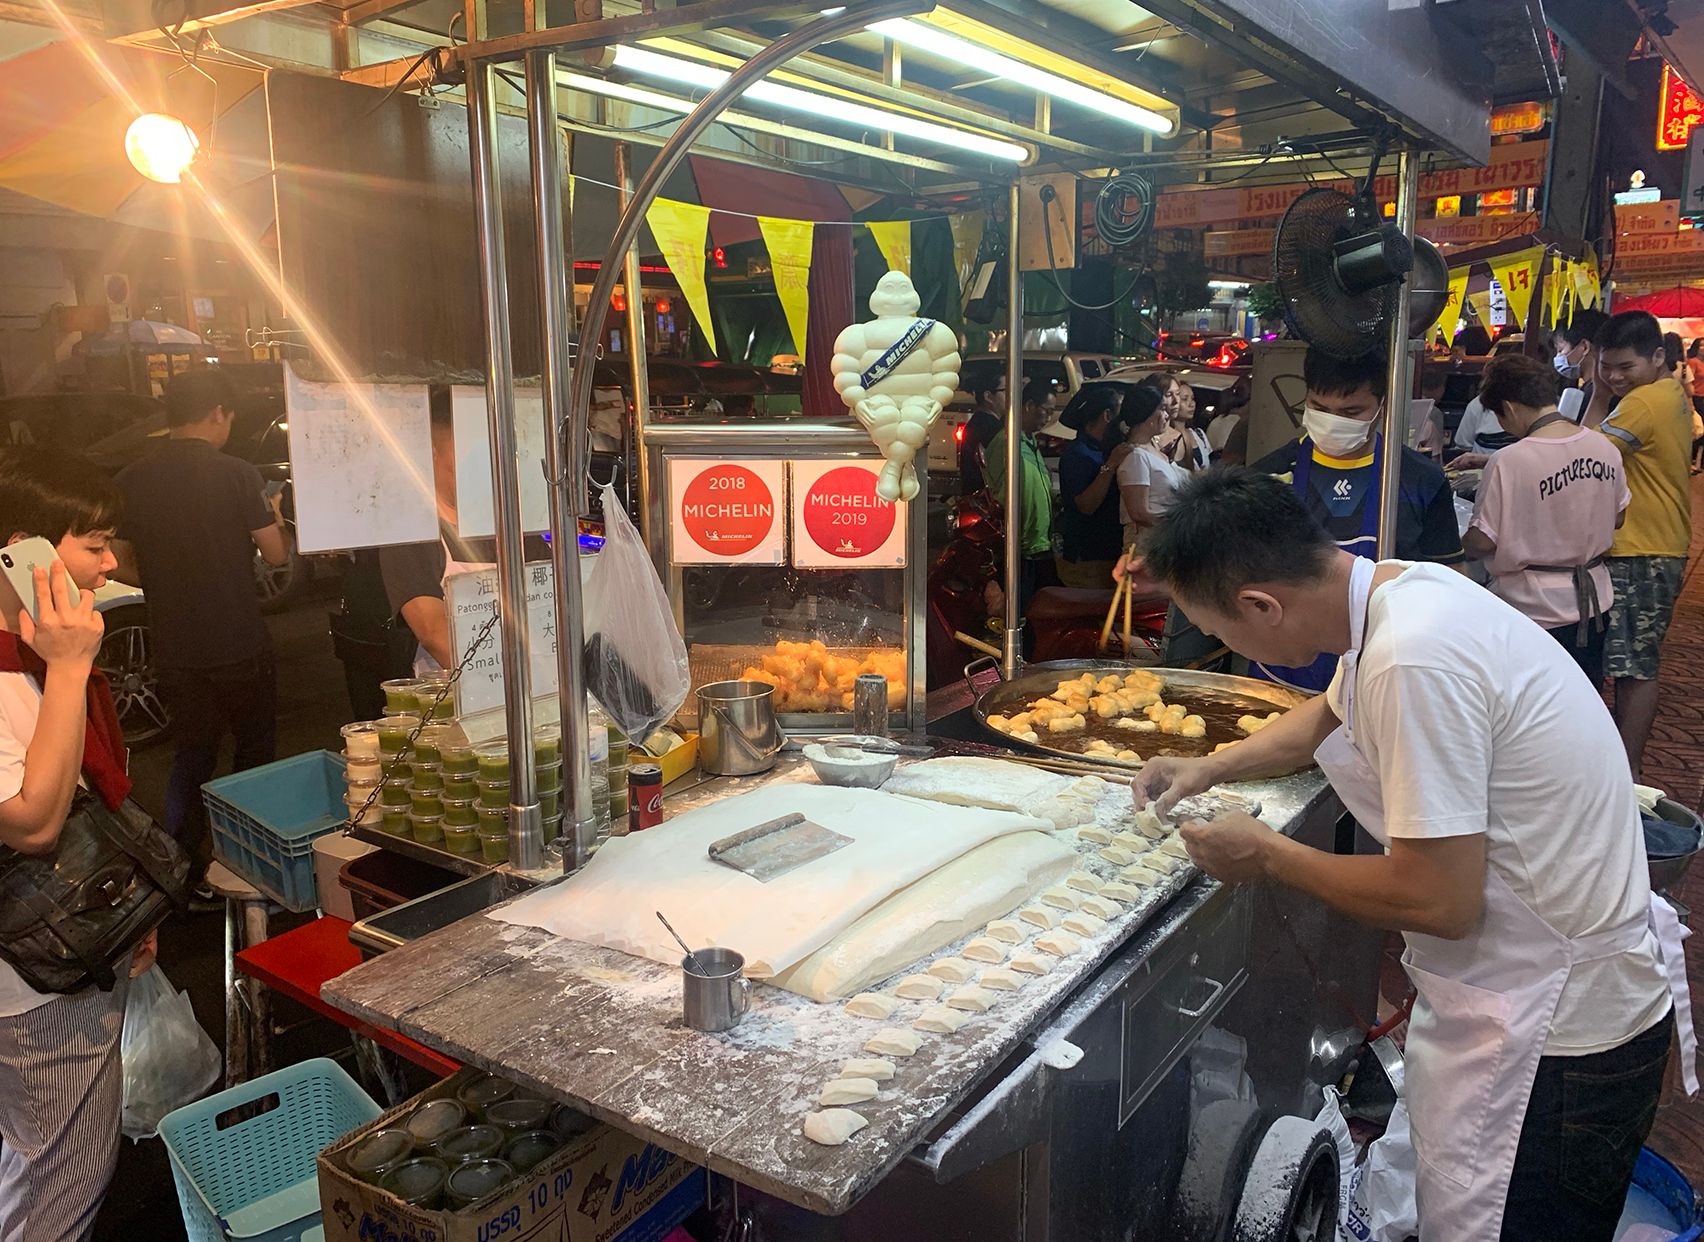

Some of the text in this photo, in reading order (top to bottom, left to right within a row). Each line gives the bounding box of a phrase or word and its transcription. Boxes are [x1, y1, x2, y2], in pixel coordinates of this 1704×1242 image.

[886, 320, 929, 366] MICHELI
[709, 477, 745, 490] 2018
[811, 493, 889, 508] MICHELIN
[684, 503, 772, 518] MICHELIN
[832, 512, 867, 526] 2019
[476, 576, 498, 596] 油
[528, 1182, 548, 1215] 10
